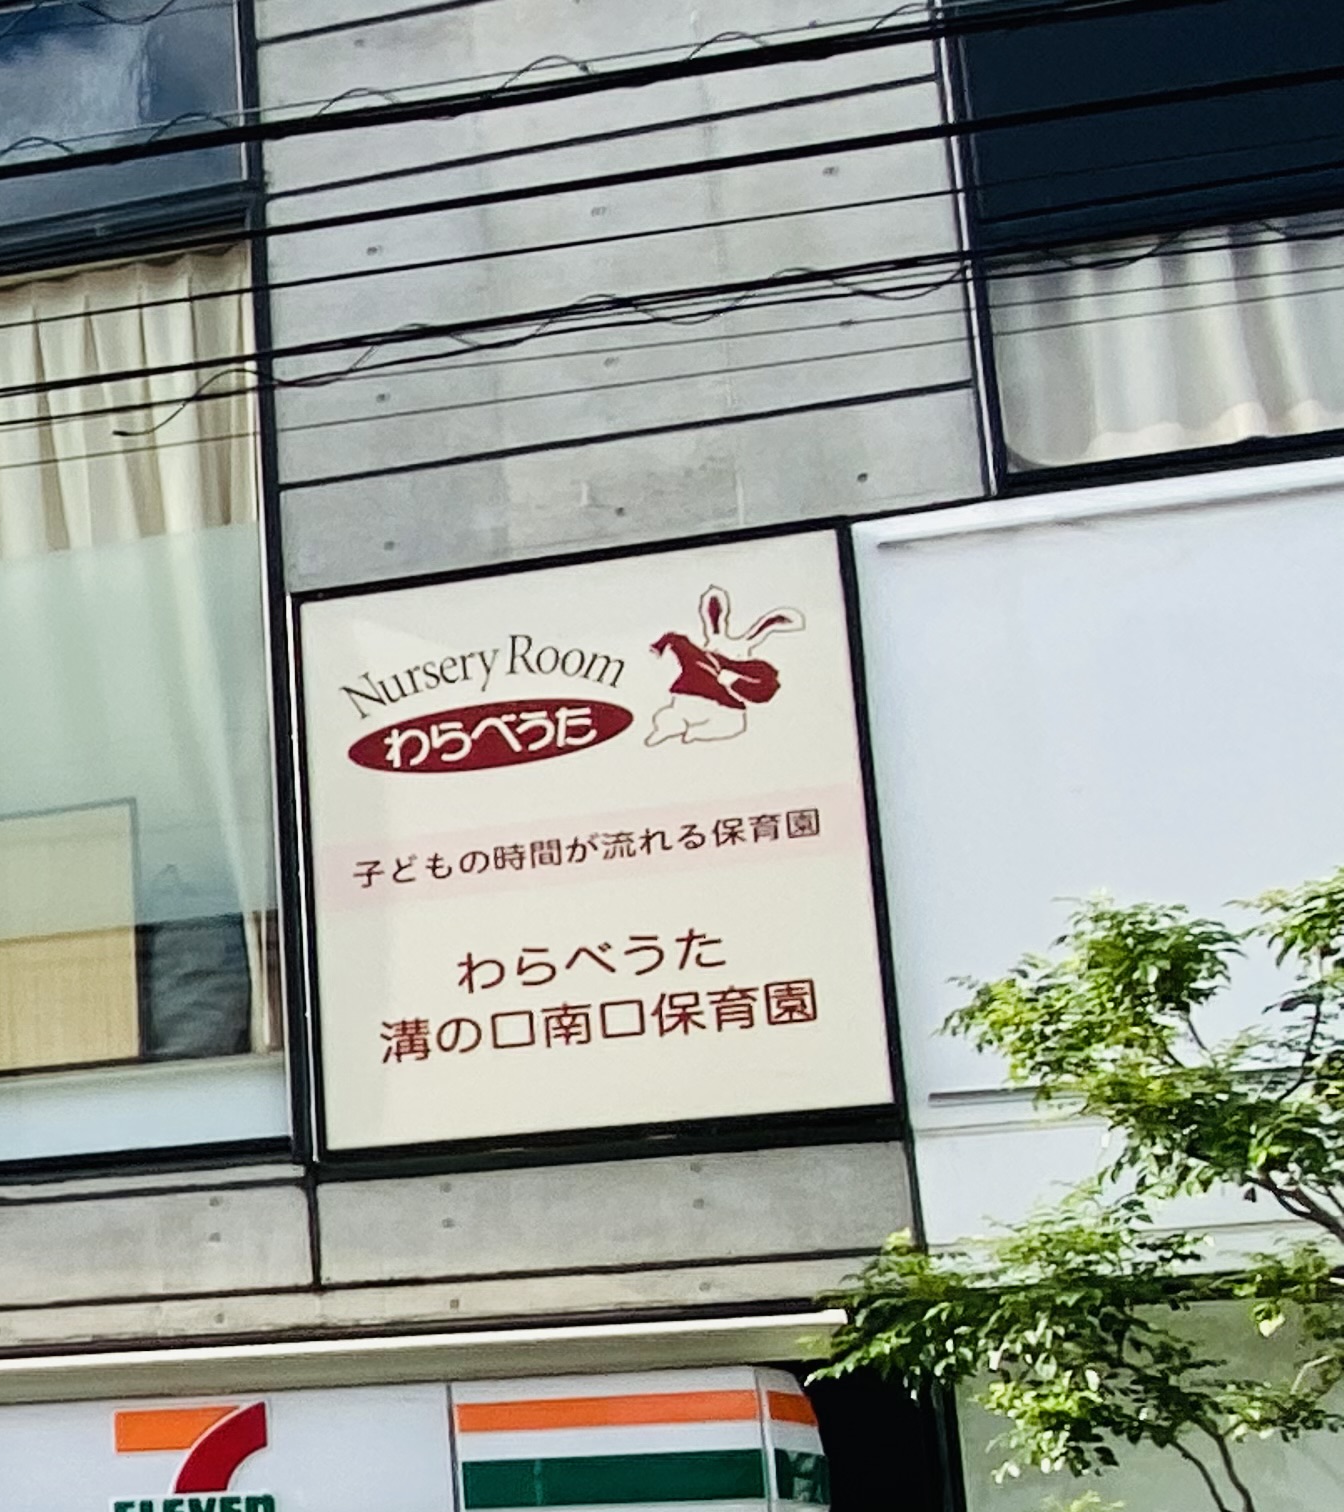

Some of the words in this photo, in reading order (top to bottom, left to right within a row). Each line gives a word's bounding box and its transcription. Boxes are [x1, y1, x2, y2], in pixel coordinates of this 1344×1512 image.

[341, 645, 500, 720] Nursery
[506, 633, 627, 690] Room
[384, 705, 598, 770] わらべうた
[352, 808, 821, 889] 子どもの時間が流れる保育園
[457, 927, 728, 994] わらべうた
[380, 978, 817, 1065] 溝の口南口保育園
